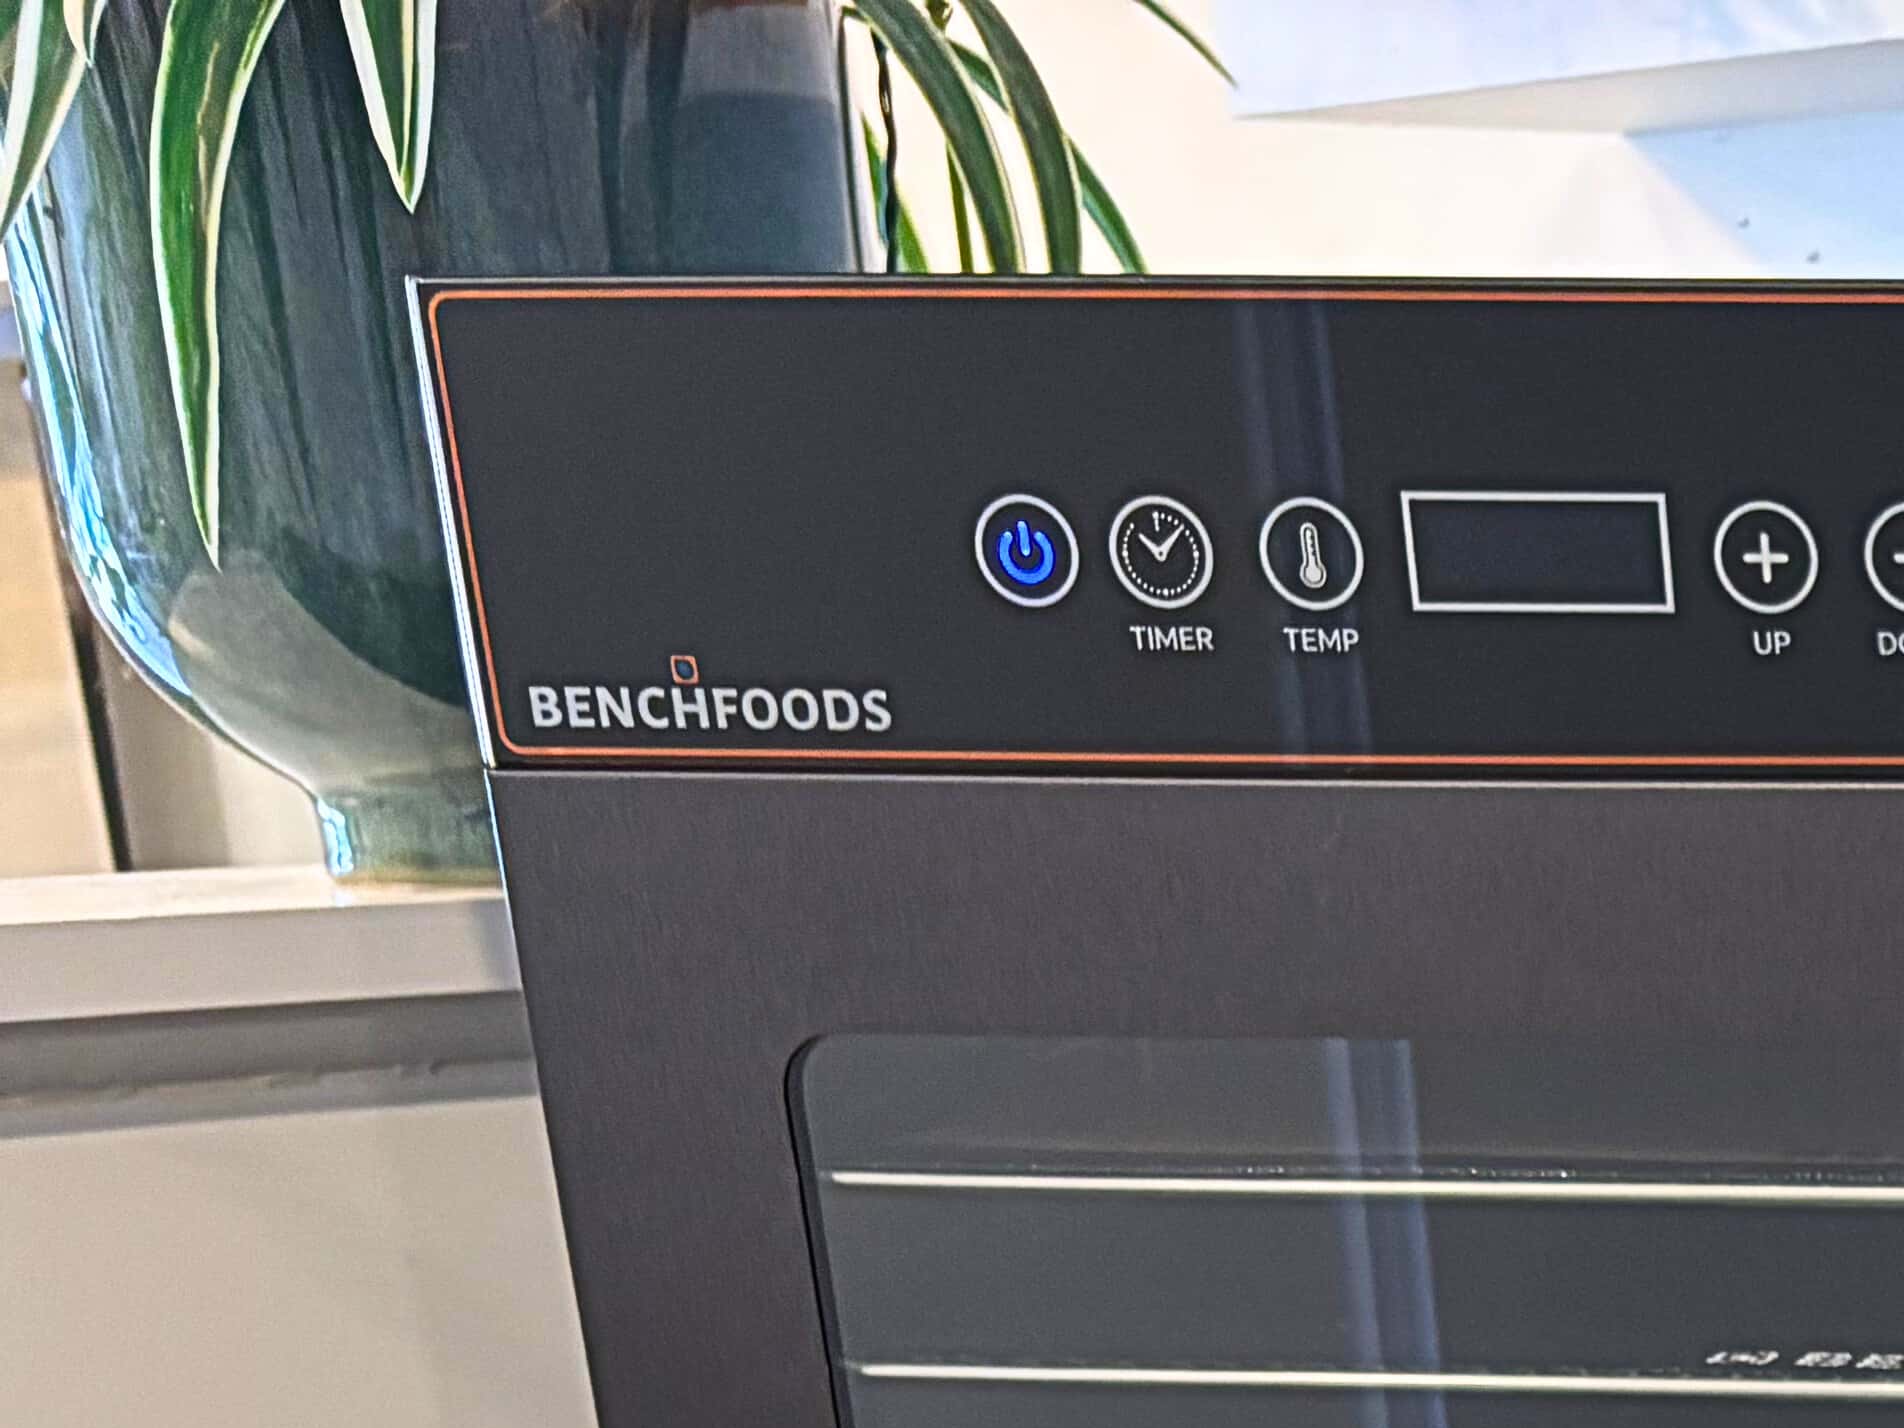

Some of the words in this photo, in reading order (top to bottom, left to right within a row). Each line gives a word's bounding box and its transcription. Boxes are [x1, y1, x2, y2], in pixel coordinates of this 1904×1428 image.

[1129, 625, 1214, 652] TIMER
[1282, 626, 1359, 653] TEMP
[1753, 631, 1792, 655] UP
[528, 682, 892, 732] BENCHFOODS
